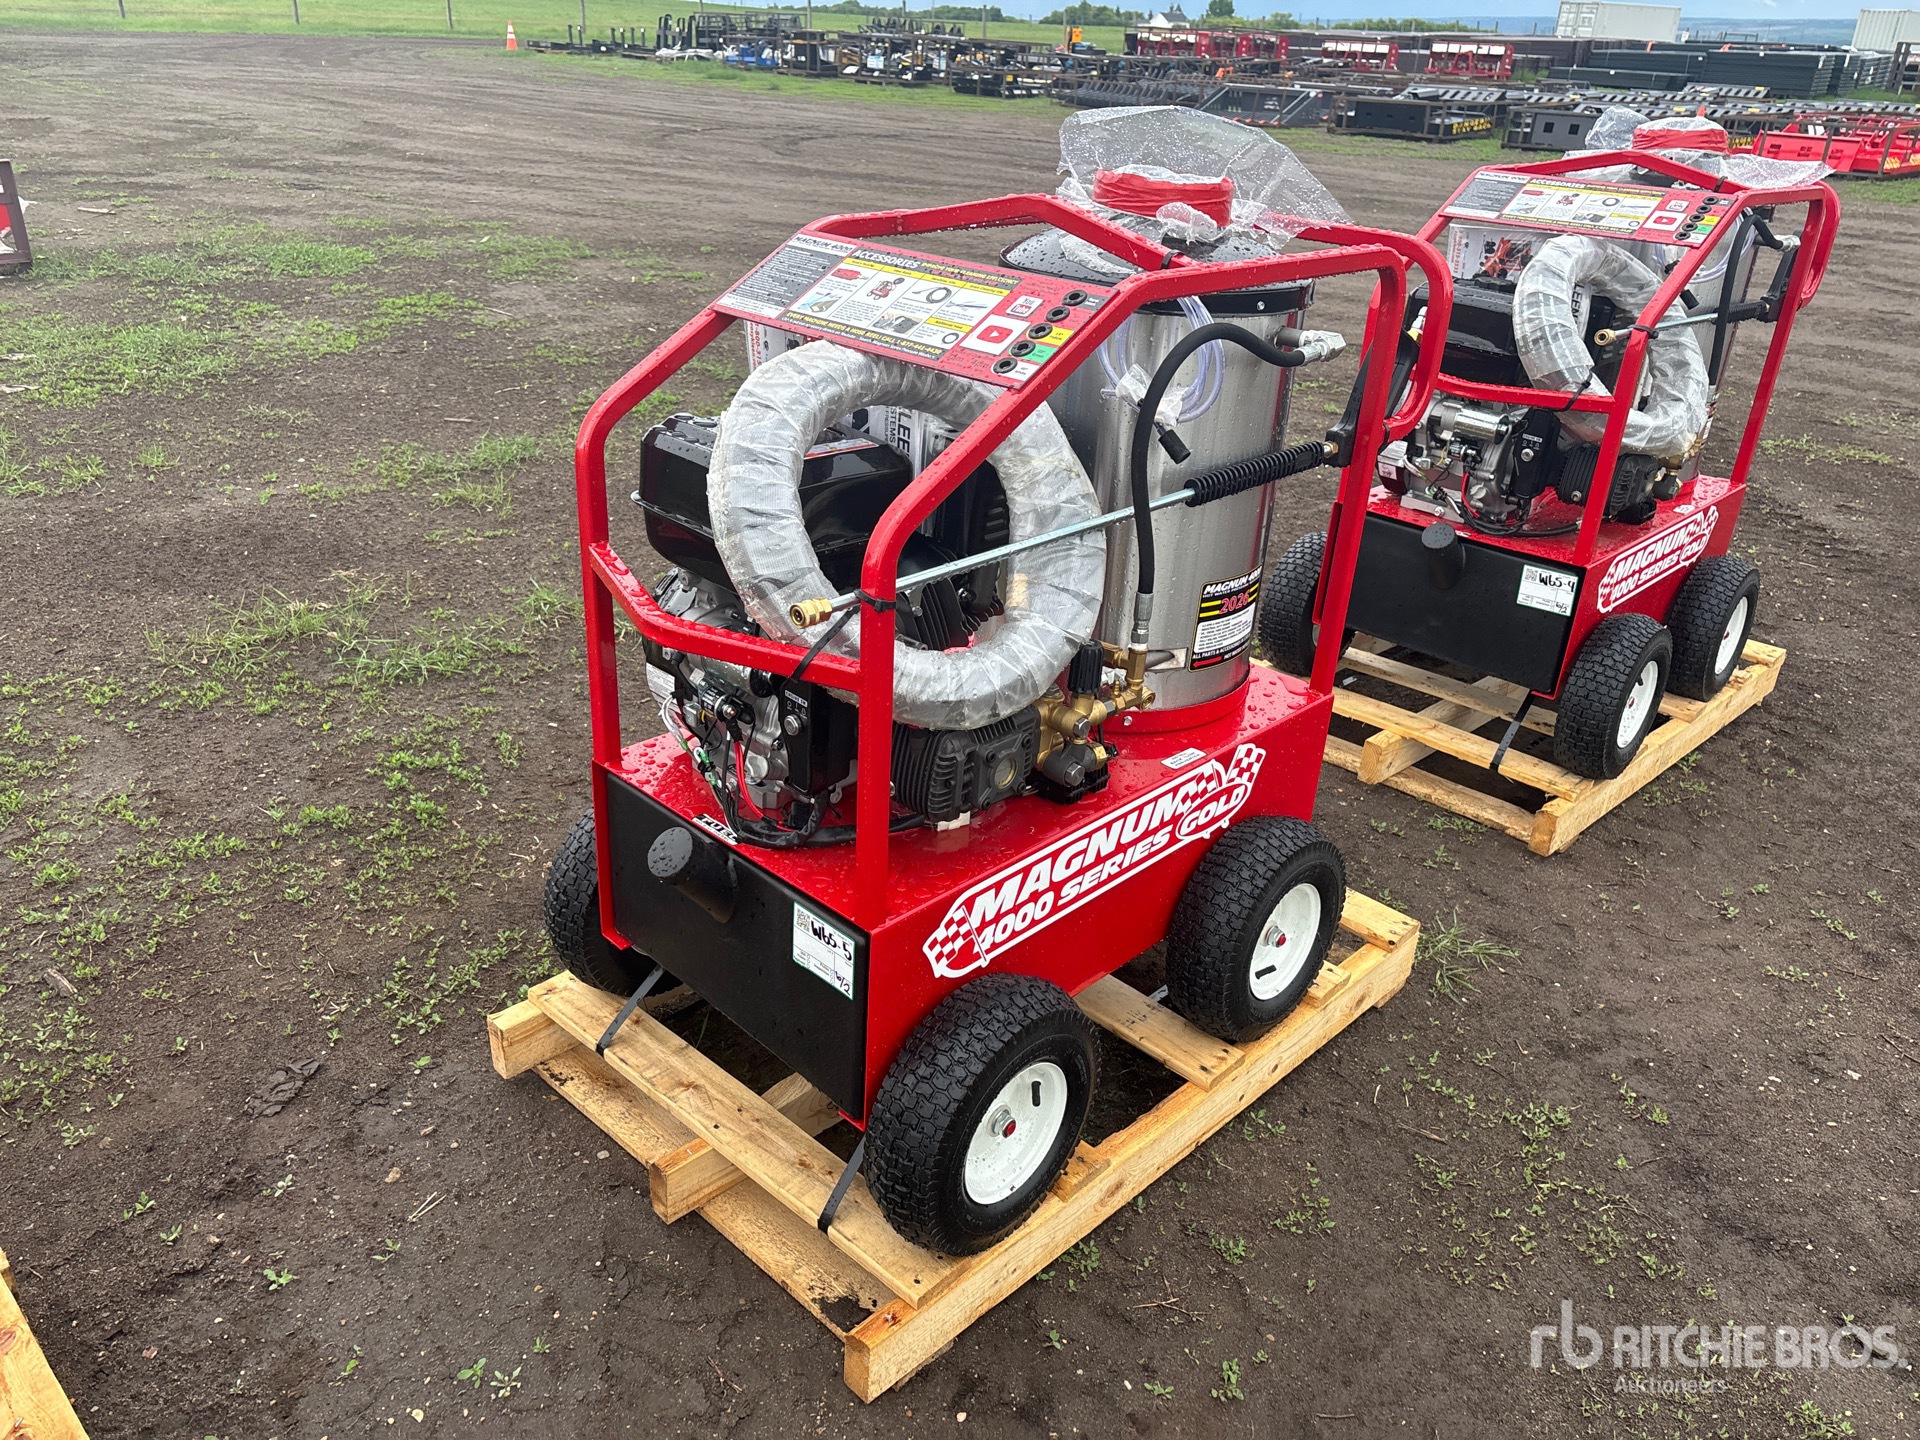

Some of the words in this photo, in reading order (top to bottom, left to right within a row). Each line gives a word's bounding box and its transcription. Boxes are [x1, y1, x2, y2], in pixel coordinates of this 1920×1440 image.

[1530, 178, 1586, 189] ACCESSORIES
[852, 250, 920, 269] ACCESSORIES
[803, 316, 829, 326] MACHINE
[1012, 305, 1030, 314] Tube
[898, 407, 911, 457] LEE
[1615, 522, 1700, 580] MAGNUM
[1681, 534, 1706, 561] GOLD
[1203, 575, 1249, 595] MAGNUM
[1611, 576, 1639, 601] 4000
[1638, 551, 1681, 581] SERIES
[1219, 589, 1250, 615] 2026
[1201, 649, 1216, 657] PARTS
[1182, 787, 1246, 837] GOLD
[701, 816, 737, 841] FUEL
[967, 777, 1205, 927] MAGNUM
[973, 890, 1055, 954] 4000
[1057, 826, 1171, 906] SERIES
